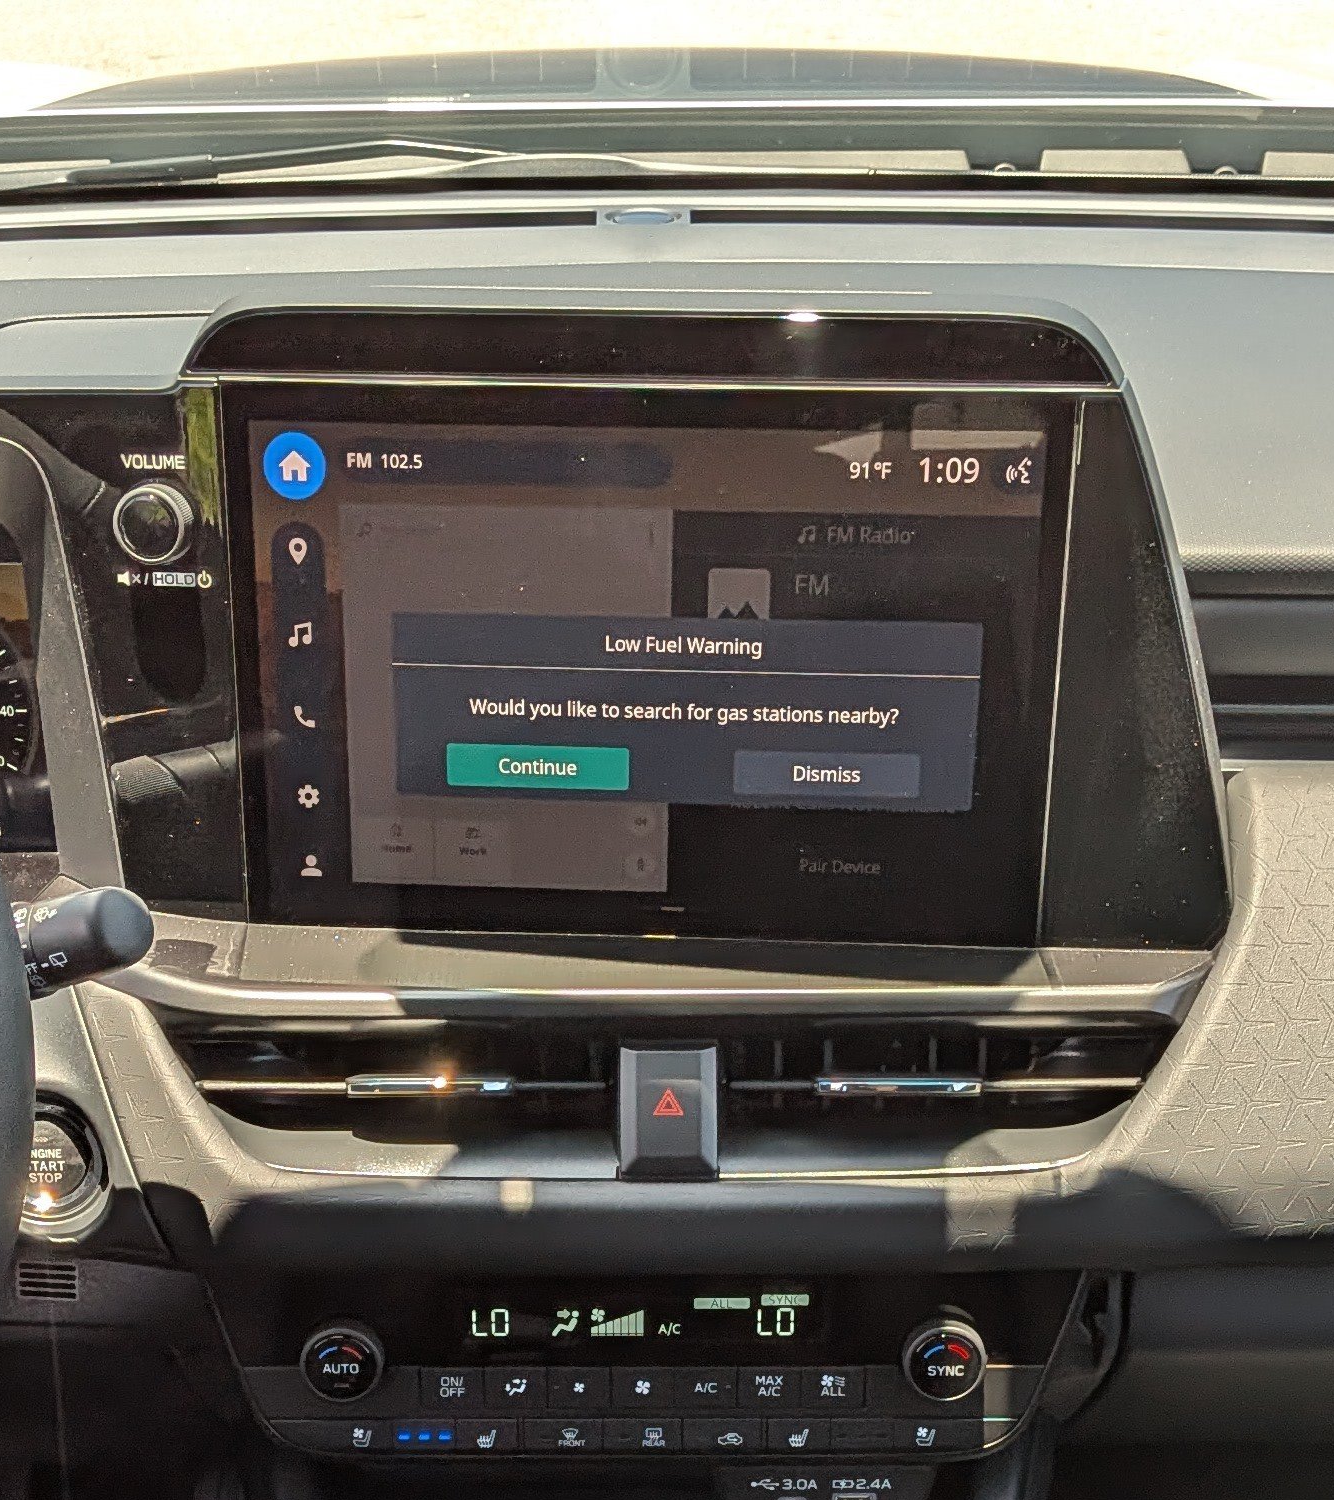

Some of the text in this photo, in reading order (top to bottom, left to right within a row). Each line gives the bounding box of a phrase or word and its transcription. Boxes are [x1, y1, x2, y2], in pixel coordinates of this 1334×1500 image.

[120, 453, 186, 470] VOLUME
[346, 452, 423, 470] FM 102.5
[919, 457, 980, 484] 1:09
[827, 526, 914, 544] FM Radio
[154, 573, 195, 585] HOLD
[795, 573, 830, 597] FM
[605, 634, 763, 660] Low Fuel Warning
[469, 698, 900, 729] Would you like to search for gas stations nearby?
[498, 757, 578, 776] Continue
[793, 764, 861, 783] Dismiss
[799, 858, 881, 875] Pair Device
[30, 1148, 62, 1159] NGINE
[29, 1160, 66, 1172] TART
[28, 1172, 63, 1183] STOP
[710, 1299, 733, 1309] ALL
[471, 1308, 510, 1338] LO
[756, 1307, 795, 1337] LO
[657, 1323, 681, 1336] A/C
[322, 1363, 360, 1375] AUTO
[927, 1365, 965, 1377] SYNC
[440, 1376, 464, 1387] ON/
[755, 1375, 783, 1386] MAX
[439, 1387, 466, 1398] OFF
[694, 1382, 718, 1394] A/C
[757, 1386, 781, 1397] A/C
[820, 1387, 846, 1397] ALL
[558, 1439, 586, 1448] FRONT
[642, 1439, 665, 1447] REAR
[782, 1479, 817, 1490] 3.0A
[856, 1478, 892, 1490] 2.4A
